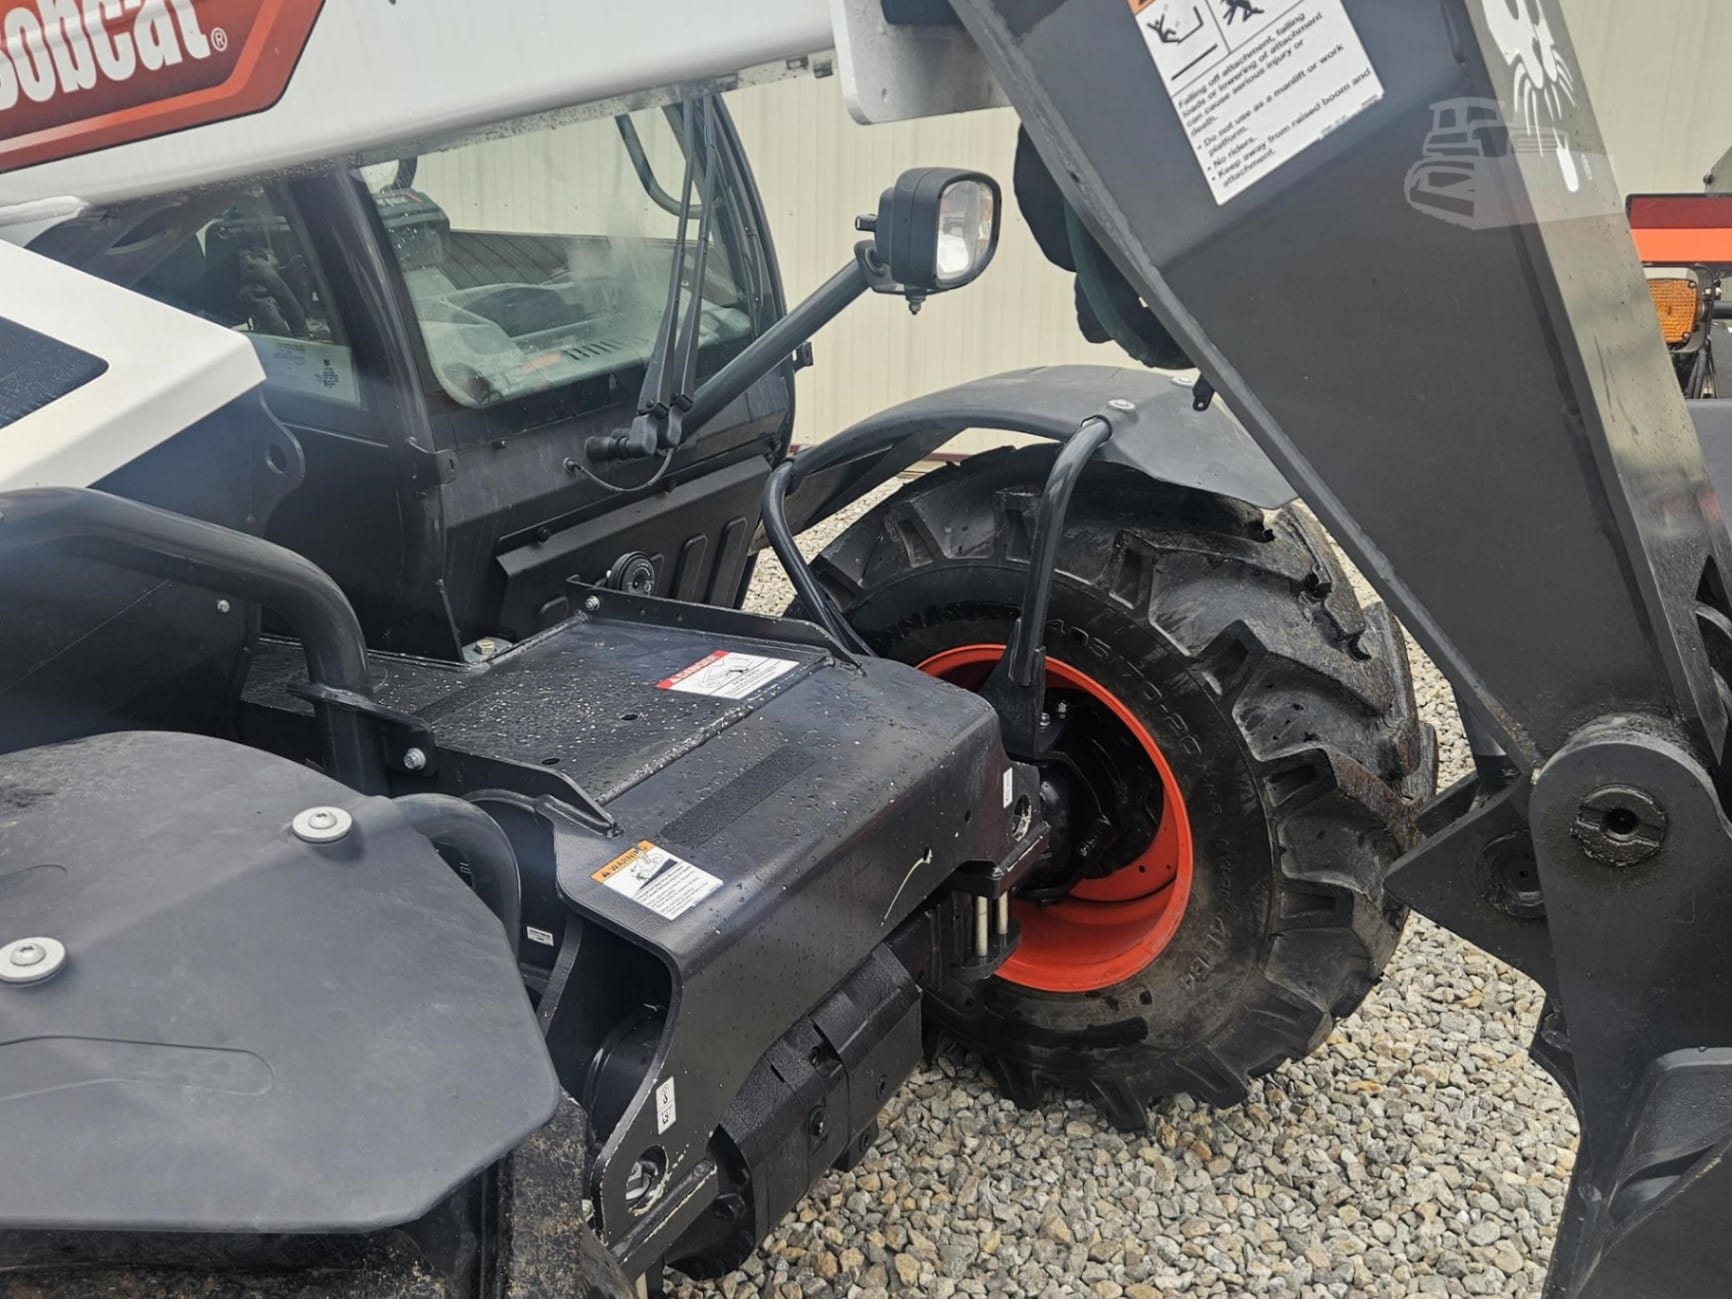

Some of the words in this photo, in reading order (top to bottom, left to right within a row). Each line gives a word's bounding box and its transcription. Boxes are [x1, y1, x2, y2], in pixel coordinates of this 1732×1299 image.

[0, 0, 211, 111] obcat
[1177, 84, 1208, 109] Falling
[1207, 72, 1221, 88] off
[1221, 35, 1276, 78] attachment,
[1275, 12, 1307, 37] falling
[1181, 97, 1207, 118] loads
[1206, 88, 1217, 101] or
[1217, 60, 1259, 92] lowering
[1257, 49, 1269, 63] of
[1265, 11, 1323, 55] attachment
[1186, 112, 1204, 128] can
[1203, 92, 1231, 115] cause
[1231, 67, 1266, 95] serious
[1265, 47, 1292, 70] injury
[1293, 38, 1304, 51] or
[1202, 134, 1218, 148] Do
[1217, 121, 1235, 137] not
[1234, 109, 1252, 126] use
[1252, 100, 1265, 113] as
[1265, 94, 1273, 104] a
[1273, 69, 1307, 98] manlift
[1306, 61, 1318, 74] or
[1318, 43, 1345, 65] work
[1190, 115, 1219, 138] death.
[1208, 126, 1249, 158] platform.
[1212, 155, 1228, 169] No
[1227, 136, 1258, 159] riders.
[1216, 158, 1242, 180] Keep
[1242, 140, 1267, 162] away
[1266, 125, 1291, 144] from
[1291, 101, 1322, 128] raised
[1321, 83, 1351, 107] boom
[1351, 67, 1372, 87] and
[1222, 147, 1277, 188] attachment.
